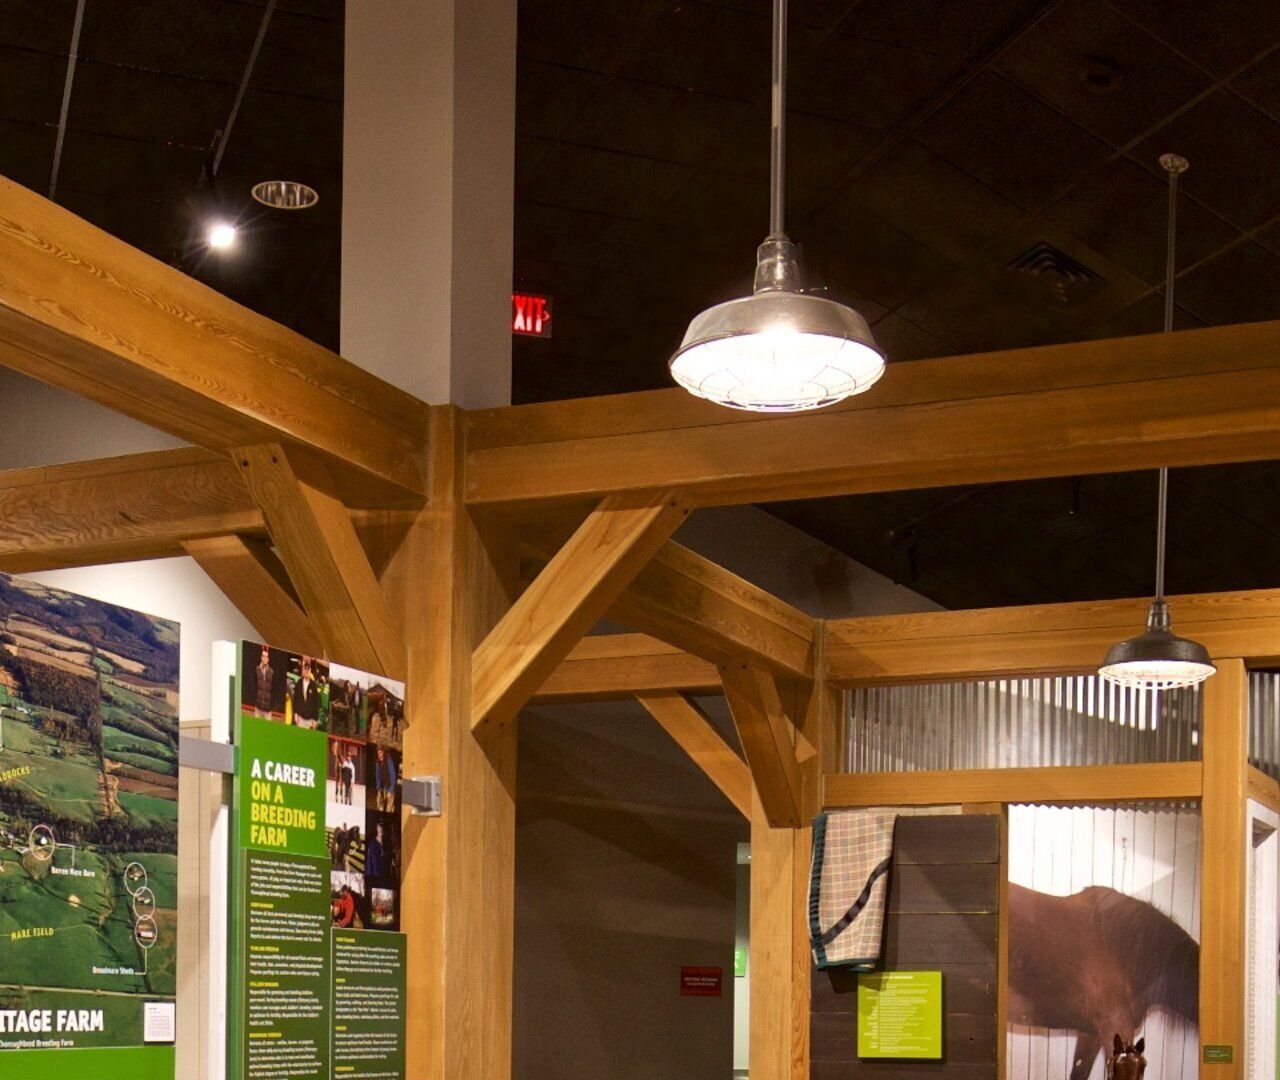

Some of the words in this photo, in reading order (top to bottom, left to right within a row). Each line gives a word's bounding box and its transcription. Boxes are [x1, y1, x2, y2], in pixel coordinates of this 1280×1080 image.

[511, 295, 546, 333] XIT
[251, 758, 262, 779] A
[264, 760, 316, 788] CAREER
[251, 780, 271, 802] ON
[274, 784, 284, 804] A
[251, 802, 316, 830] BREEDING
[251, 824, 287, 847] FARM
[11, 927, 31, 940] MARE
[33, 926, 54, 937] FIELD
[56, 1009, 104, 1031] FARM
[36, 1039, 60, 1049] Breeding
